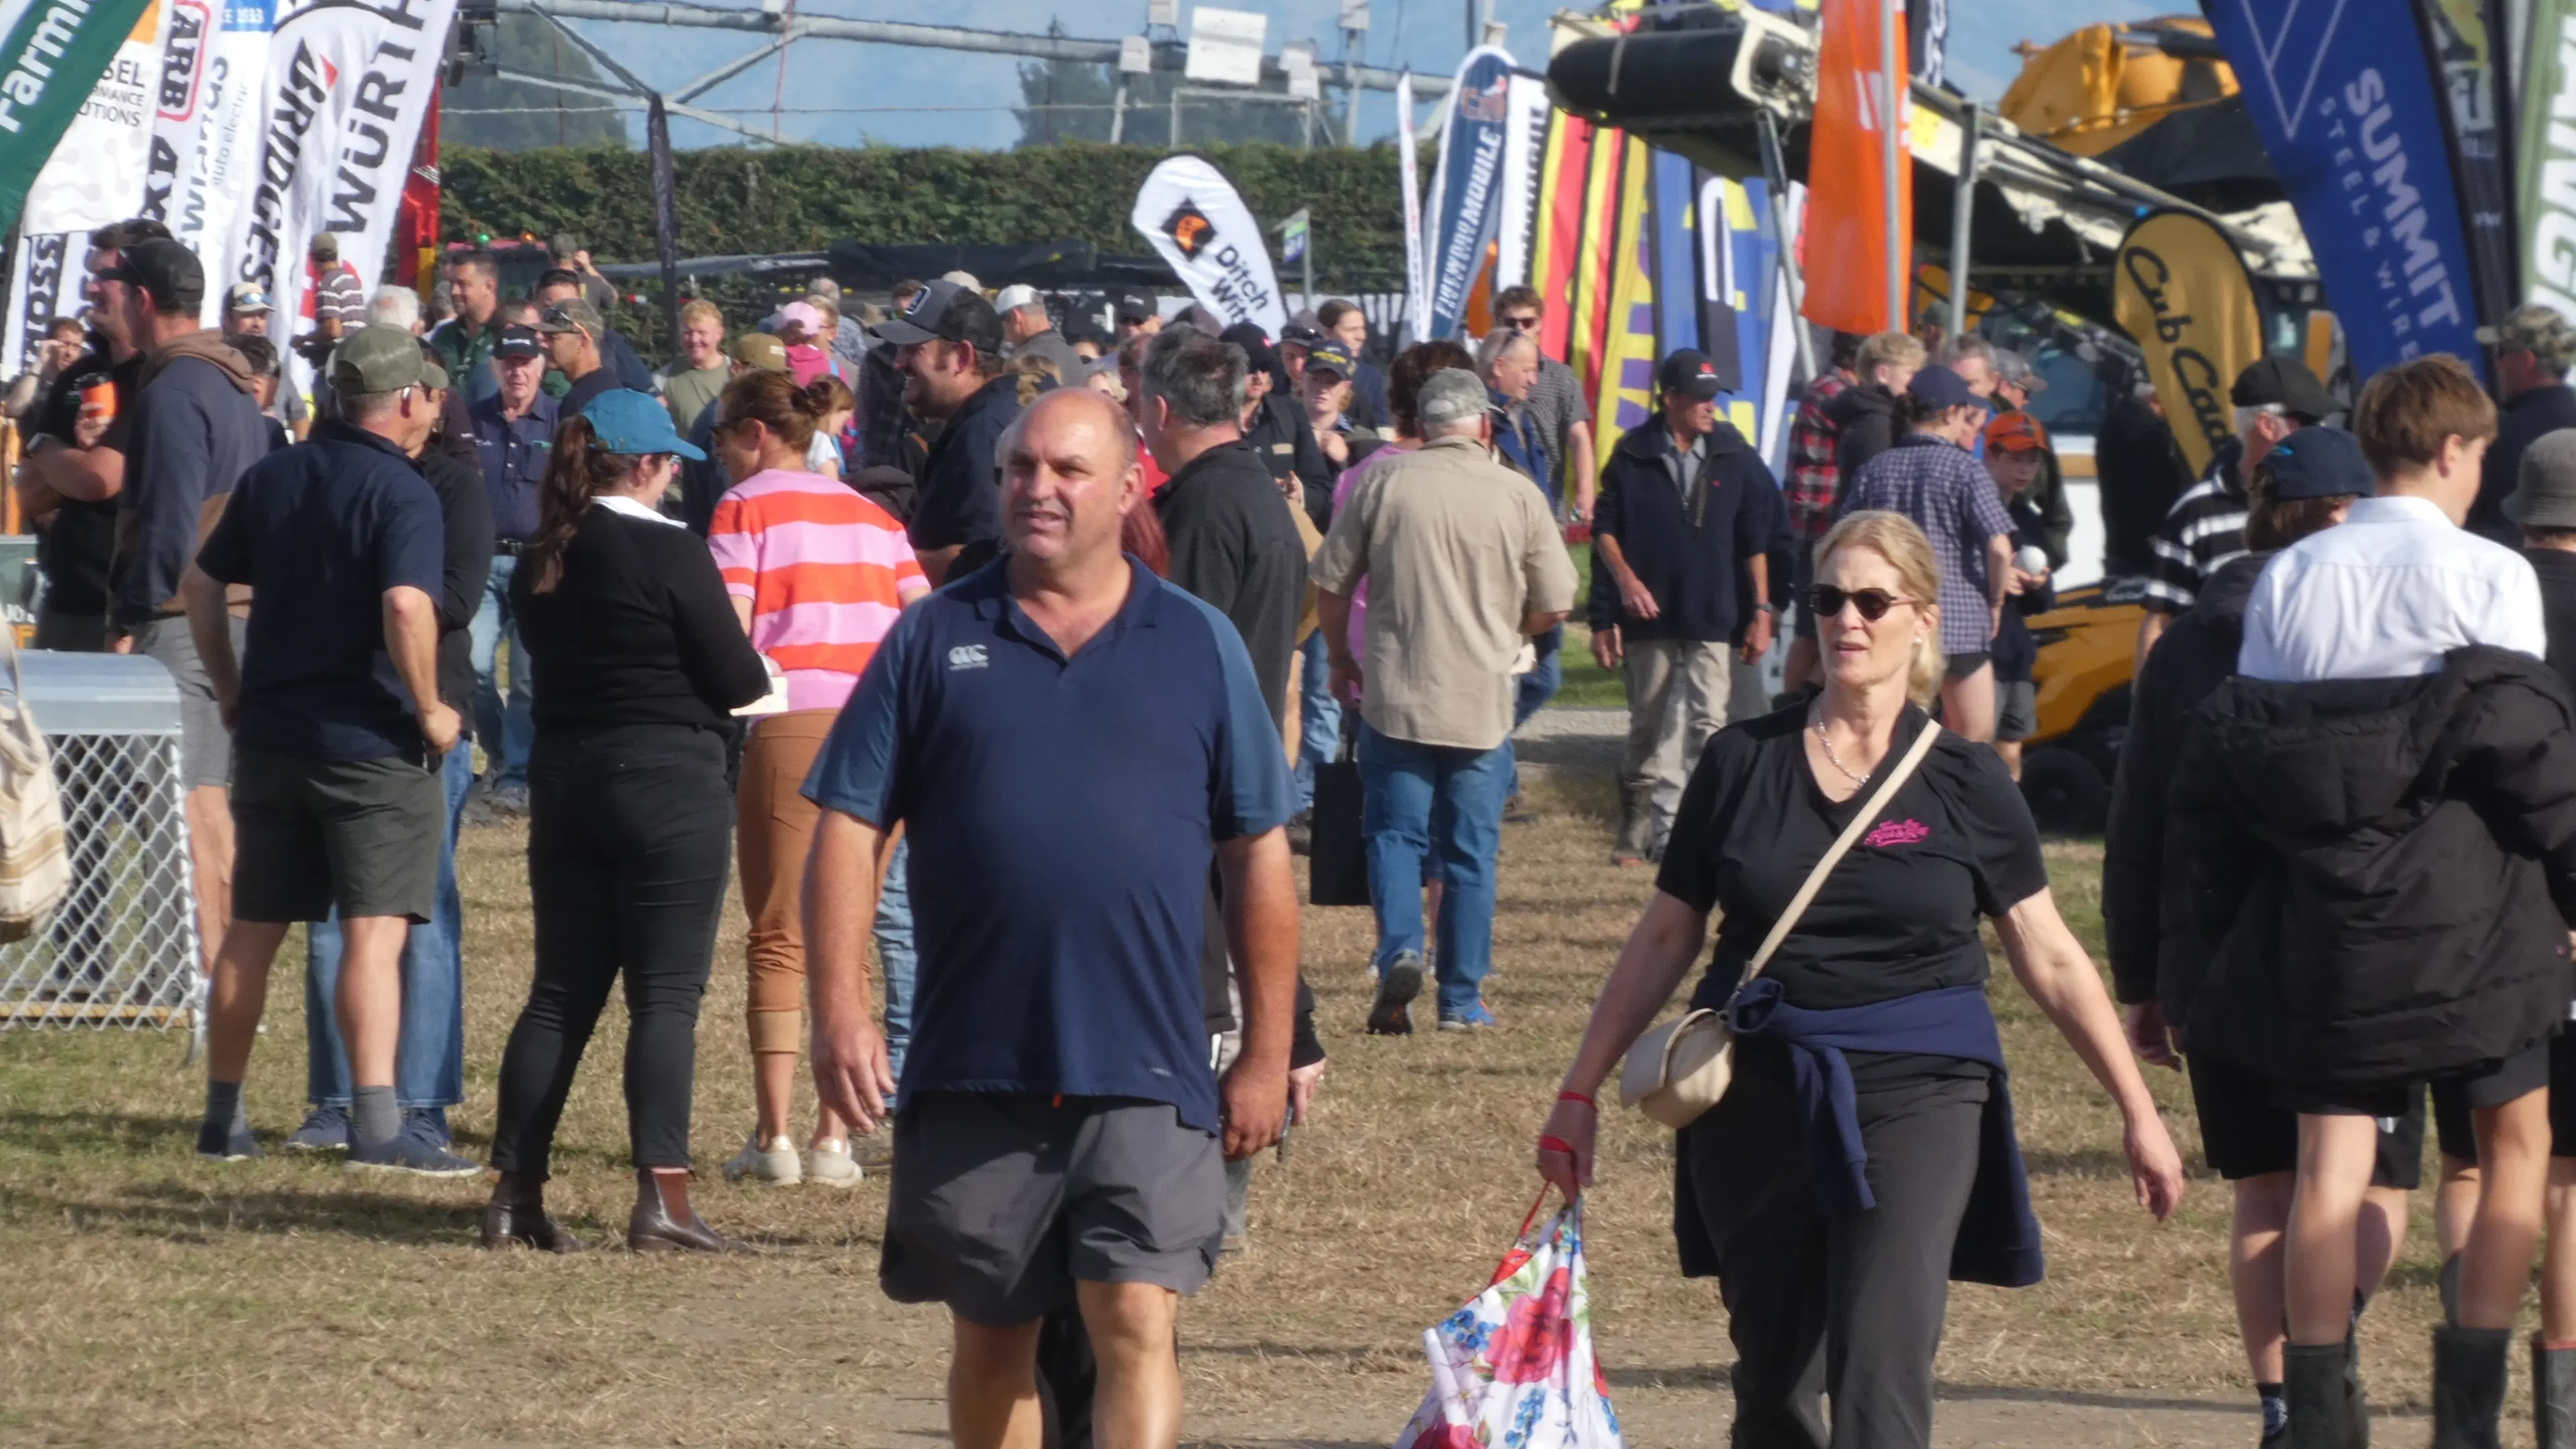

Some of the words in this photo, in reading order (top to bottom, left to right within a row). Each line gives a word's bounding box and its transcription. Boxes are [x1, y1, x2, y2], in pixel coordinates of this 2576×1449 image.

[0, 0, 95, 133] Farml
[159, 9, 201, 109] ARB
[138, 134, 178, 223] 4X
[238, 36, 326, 290] BRIDGES
[2320, 96, 2369, 216] STEEL
[2345, 67, 2461, 328] SUMMIT
[1216, 245, 1269, 311] Ditch
[2124, 246, 2194, 343] Cub
